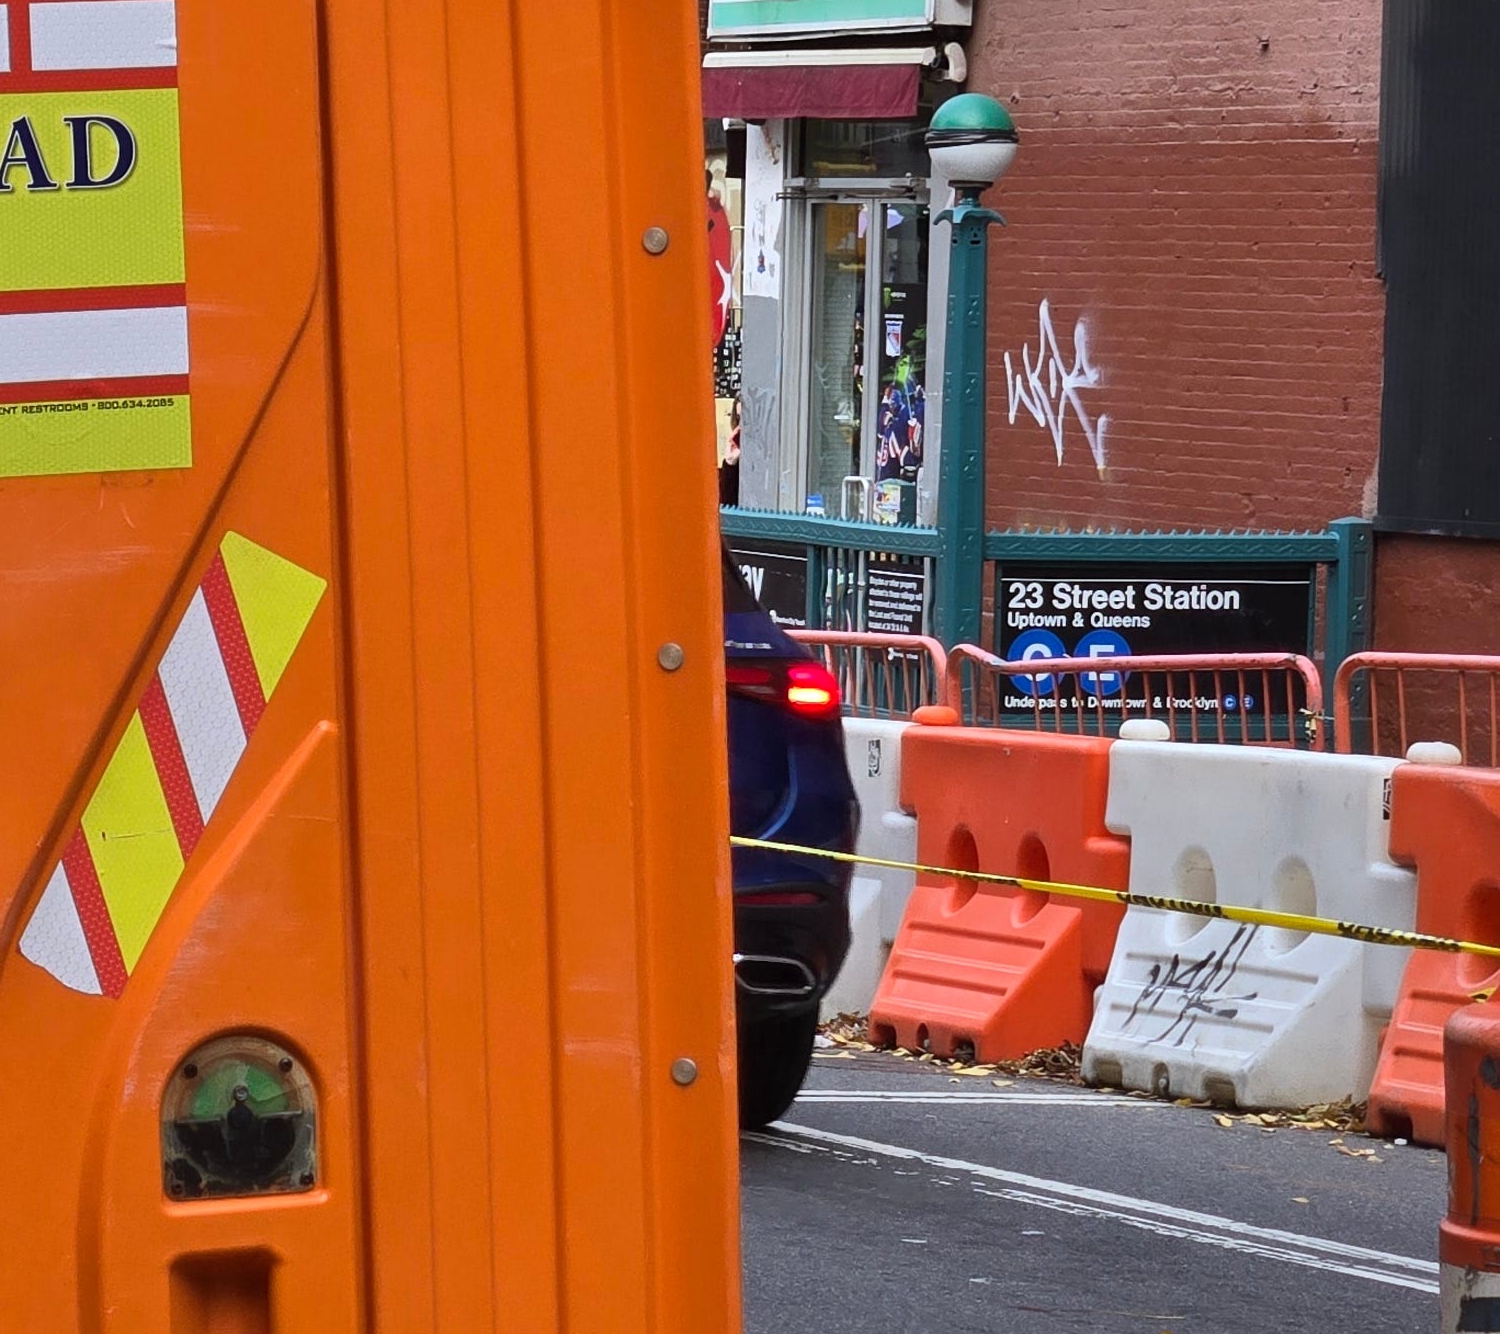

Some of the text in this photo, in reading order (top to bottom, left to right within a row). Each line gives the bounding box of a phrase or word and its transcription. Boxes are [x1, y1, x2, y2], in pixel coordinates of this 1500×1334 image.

[21, 402, 89, 414] RESTROOMS
[1008, 582, 1240, 610] 23 Street Station
[1007, 611, 1151, 630] Uptown & Queens
[1004, 694, 1068, 710] Undepas
[1152, 696, 1163, 709] &
